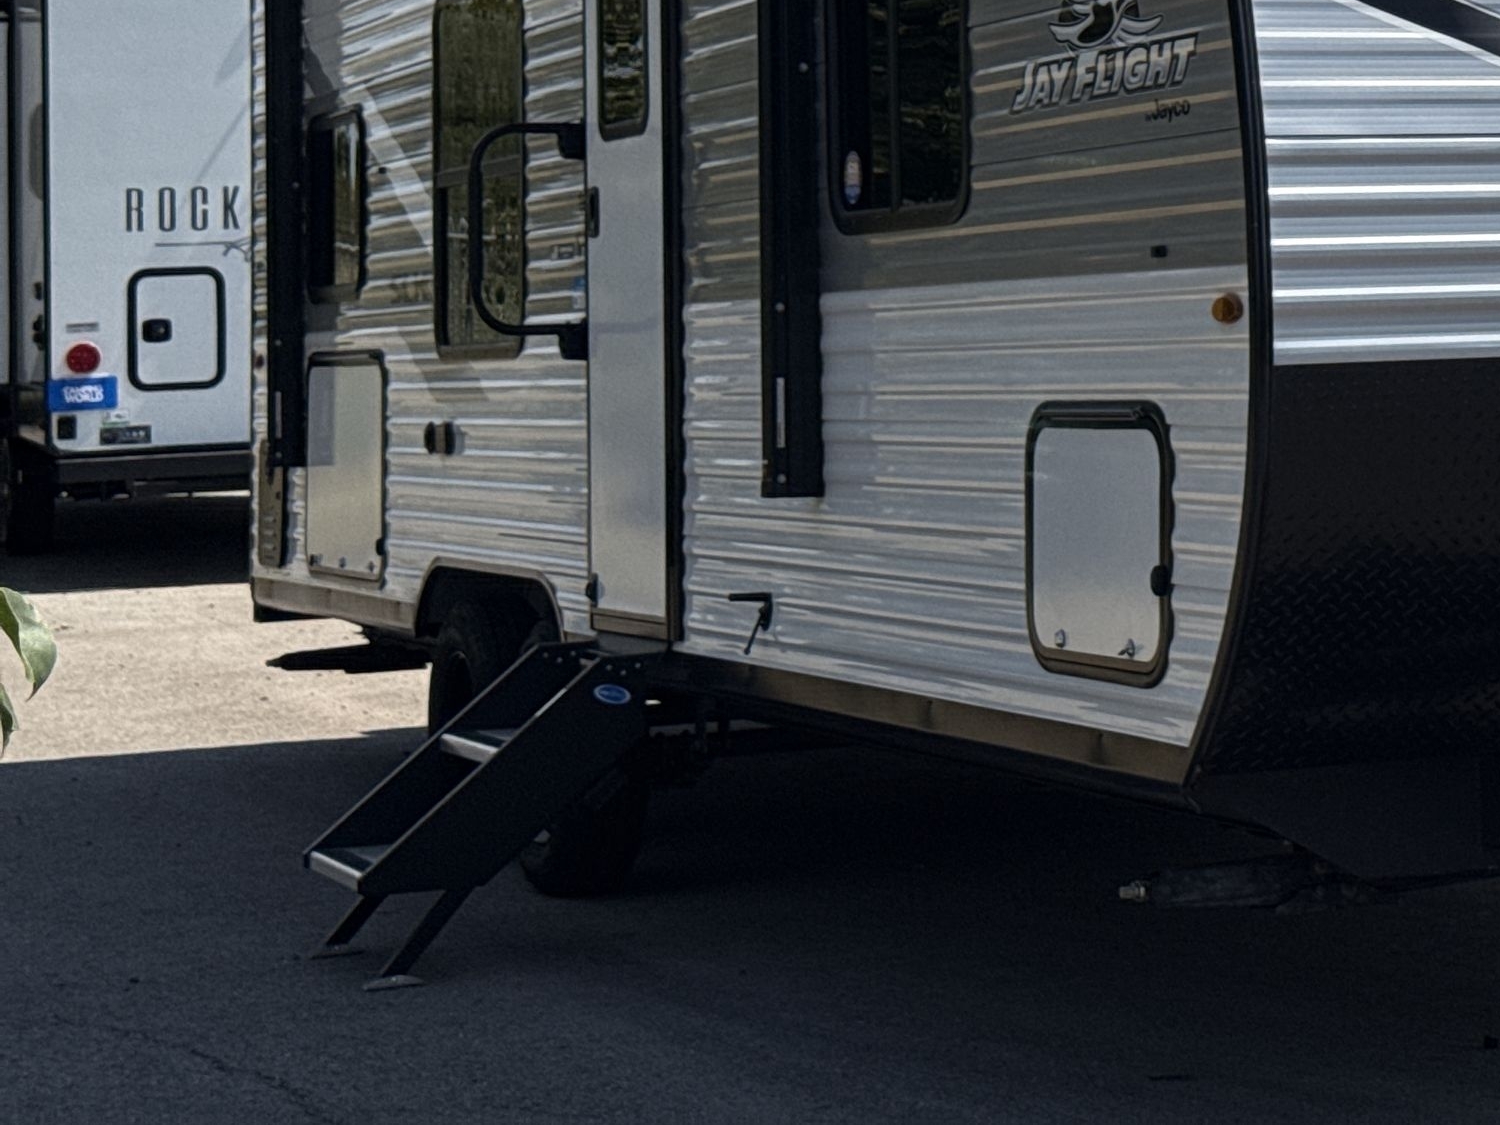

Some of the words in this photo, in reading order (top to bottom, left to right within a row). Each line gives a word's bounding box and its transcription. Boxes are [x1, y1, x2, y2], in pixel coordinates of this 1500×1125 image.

[1008, 57, 1074, 115] JAY
[1066, 32, 1200, 103] FLIGHT
[1152, 98, 1191, 123] Jayco
[125, 185, 241, 233] ROCK
